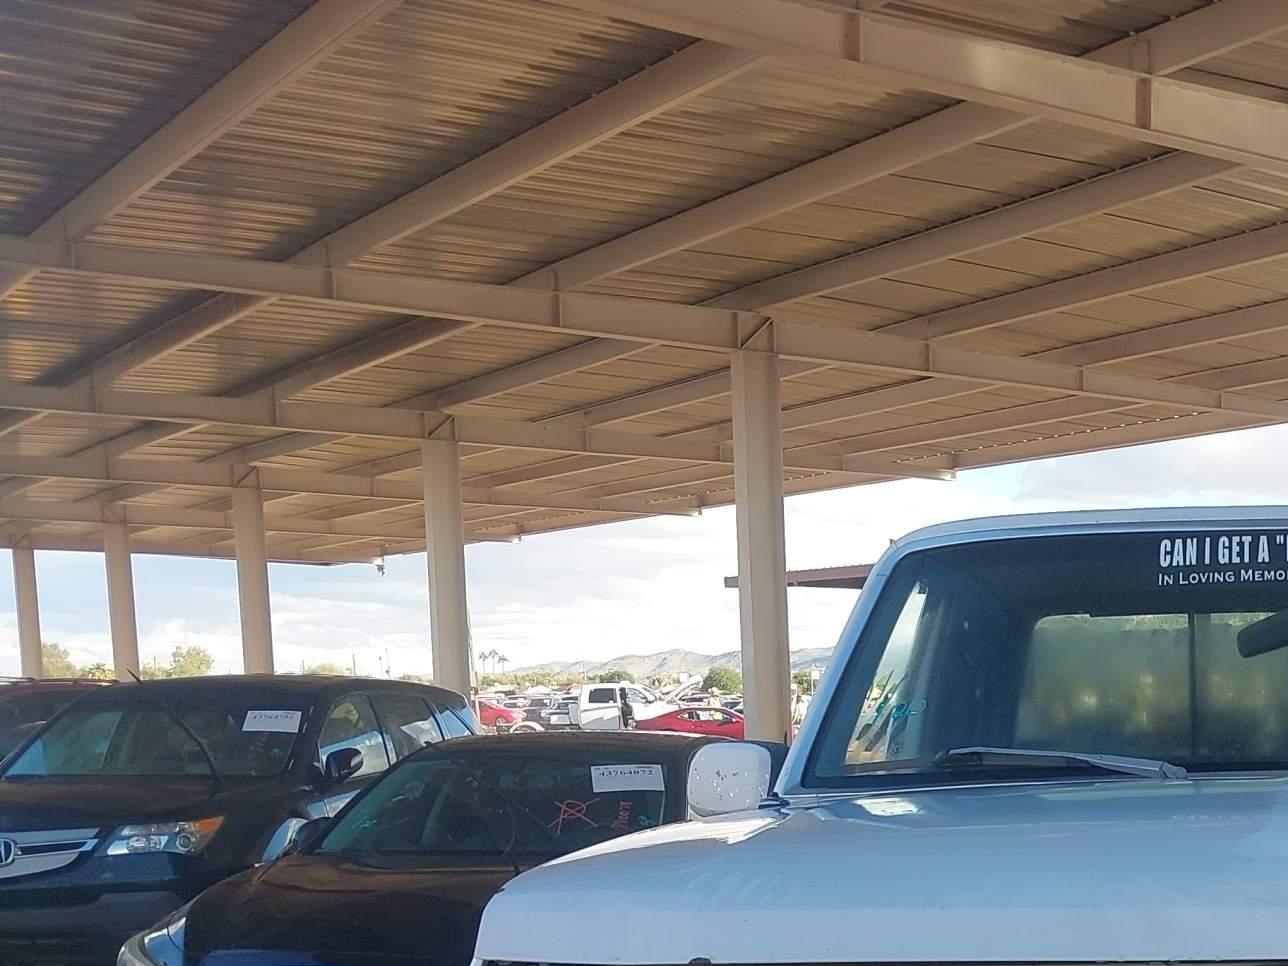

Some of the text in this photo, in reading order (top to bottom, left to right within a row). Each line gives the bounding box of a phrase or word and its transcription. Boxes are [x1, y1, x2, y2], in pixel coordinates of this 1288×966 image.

[1159, 537, 1197, 567] CAN
[1204, 537, 1211, 565] I
[1218, 535, 1252, 564] GET
[1257, 535, 1270, 563] A
[1179, 571, 1235, 585] LOVING
